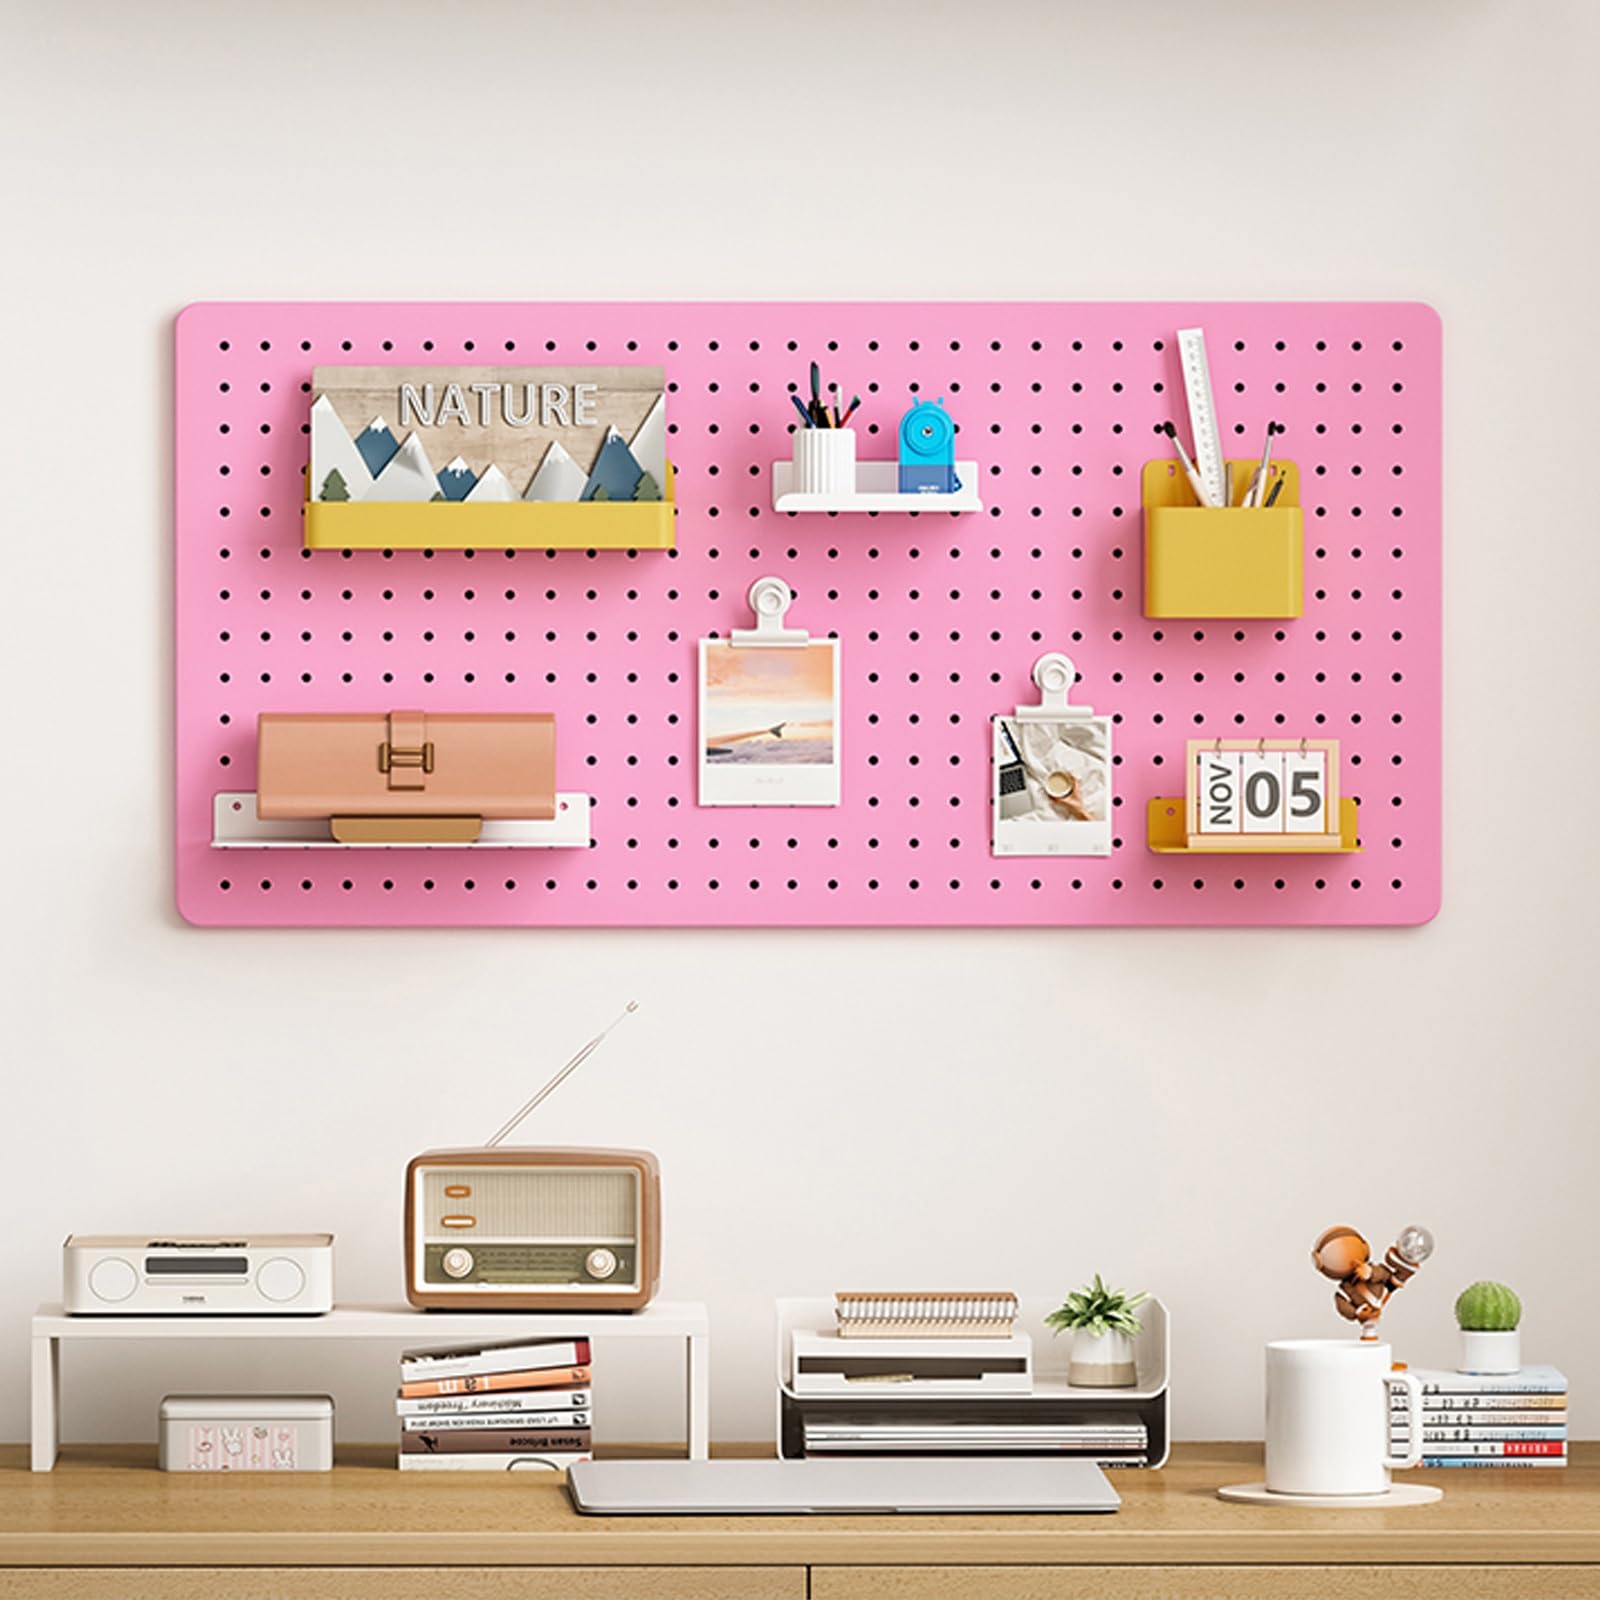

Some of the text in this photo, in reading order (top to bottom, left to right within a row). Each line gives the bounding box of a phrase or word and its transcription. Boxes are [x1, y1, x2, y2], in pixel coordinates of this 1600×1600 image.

[397, 381, 599, 427] NATURE
[1209, 763, 1321, 824] NOV 05
